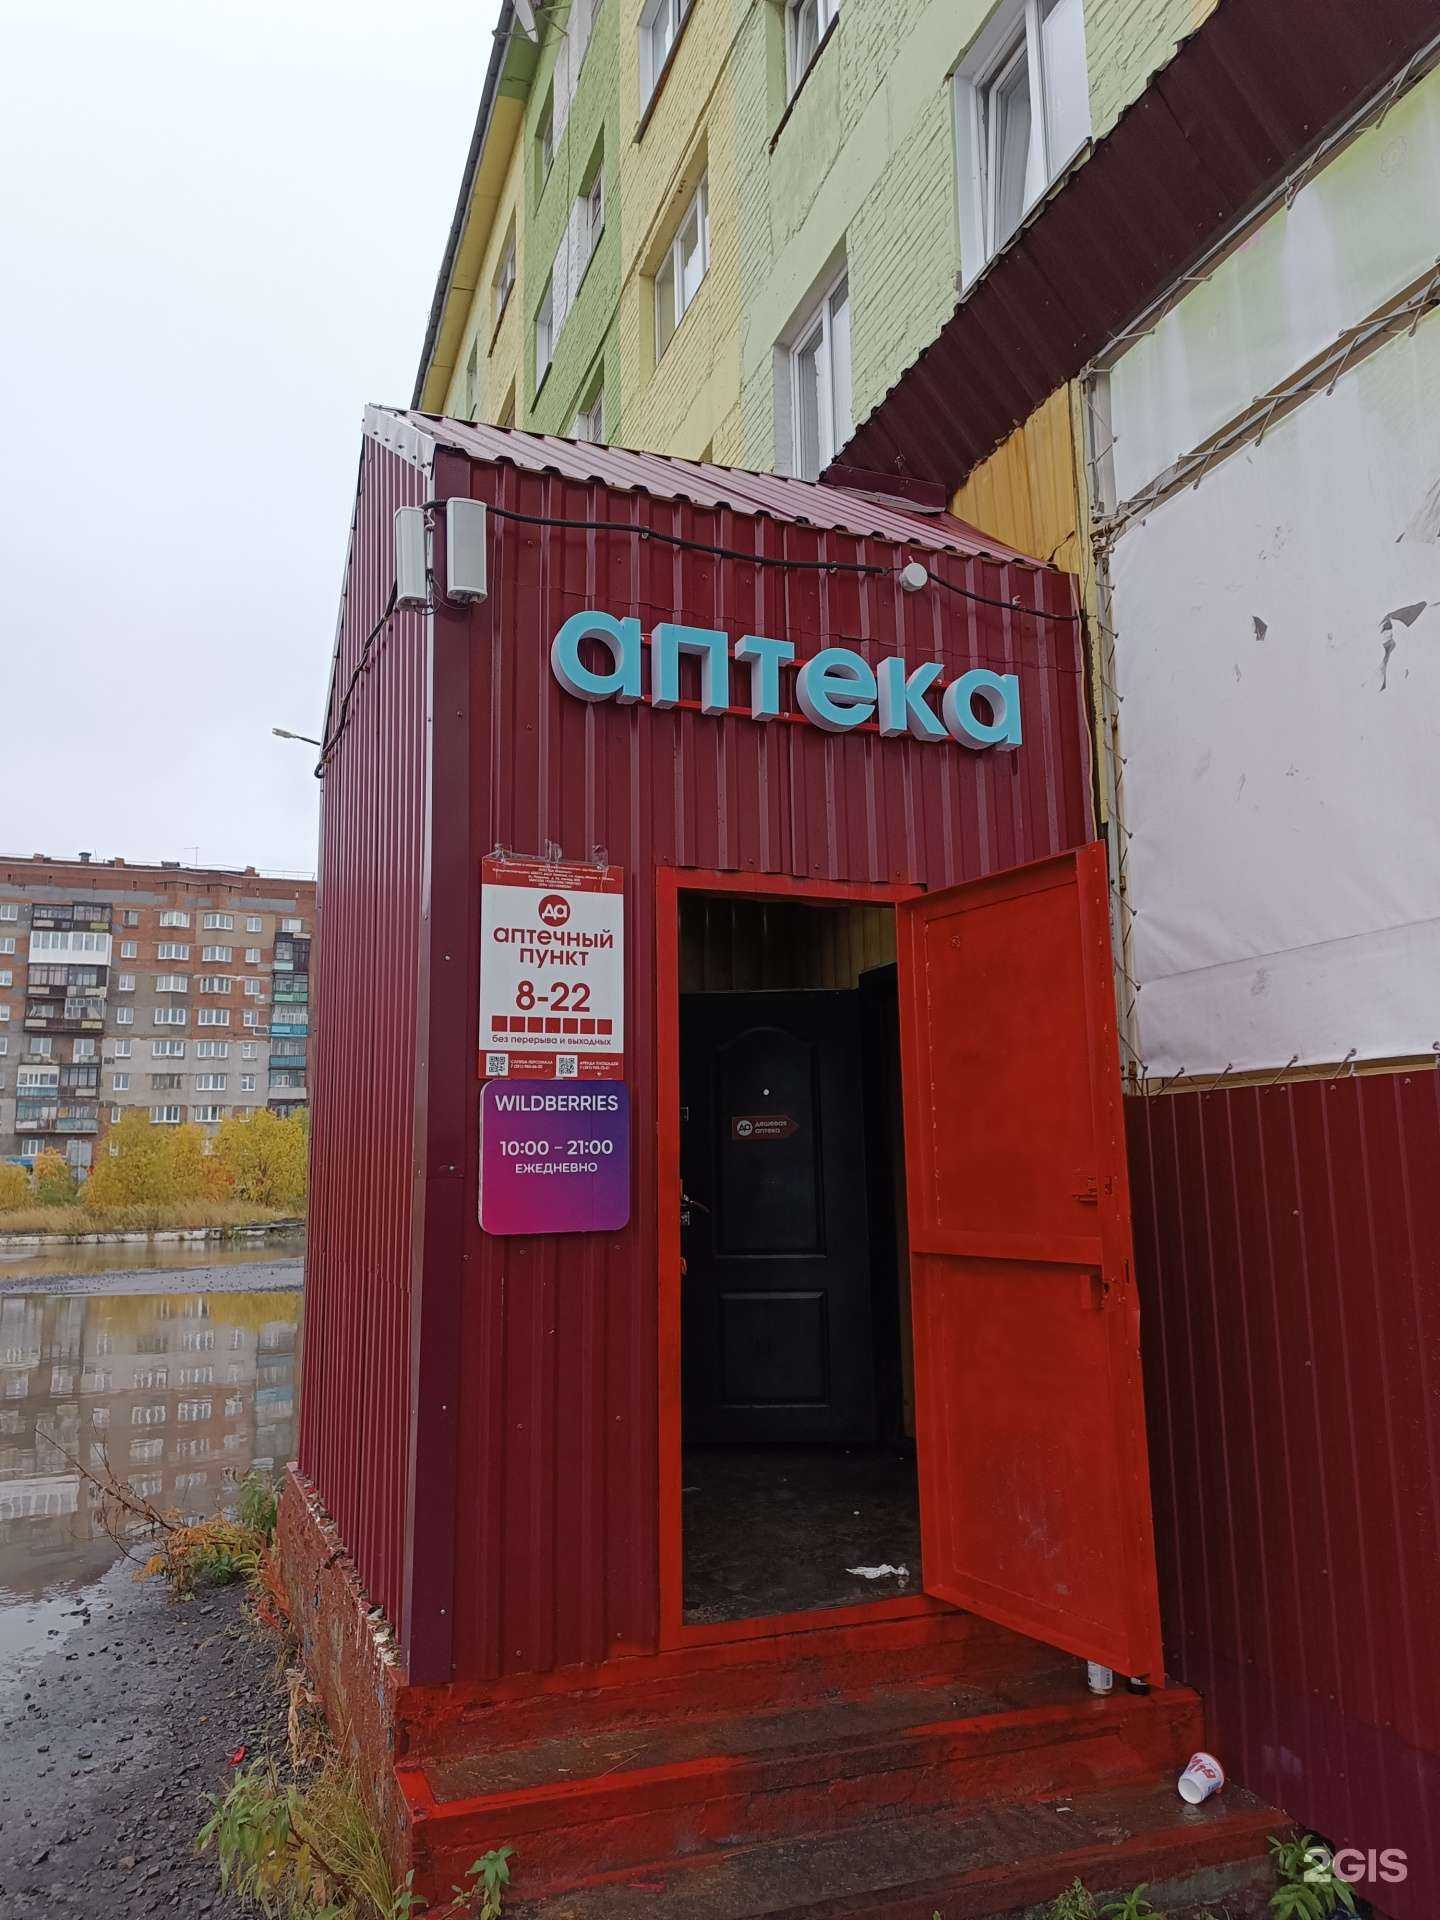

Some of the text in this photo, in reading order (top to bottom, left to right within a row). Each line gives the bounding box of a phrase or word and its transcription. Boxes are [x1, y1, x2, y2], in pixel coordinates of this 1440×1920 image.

[551, 610, 1023, 751] аптека
[493, 927, 614, 949] аптечный
[520, 948, 589, 968] пункт
[515, 980, 591, 1013] 8-22
[492, 1034, 509, 1044] без
[510, 1036, 557, 1046] перерыва
[567, 1038, 612, 1047] выходных
[495, 1095, 619, 1112] WILDBERRIES
[499, 1140, 549, 1156] 10:00
[567, 1139, 614, 1155] 21:00
[515, 1162, 598, 1175] ЕЖЕДНЕВНО
